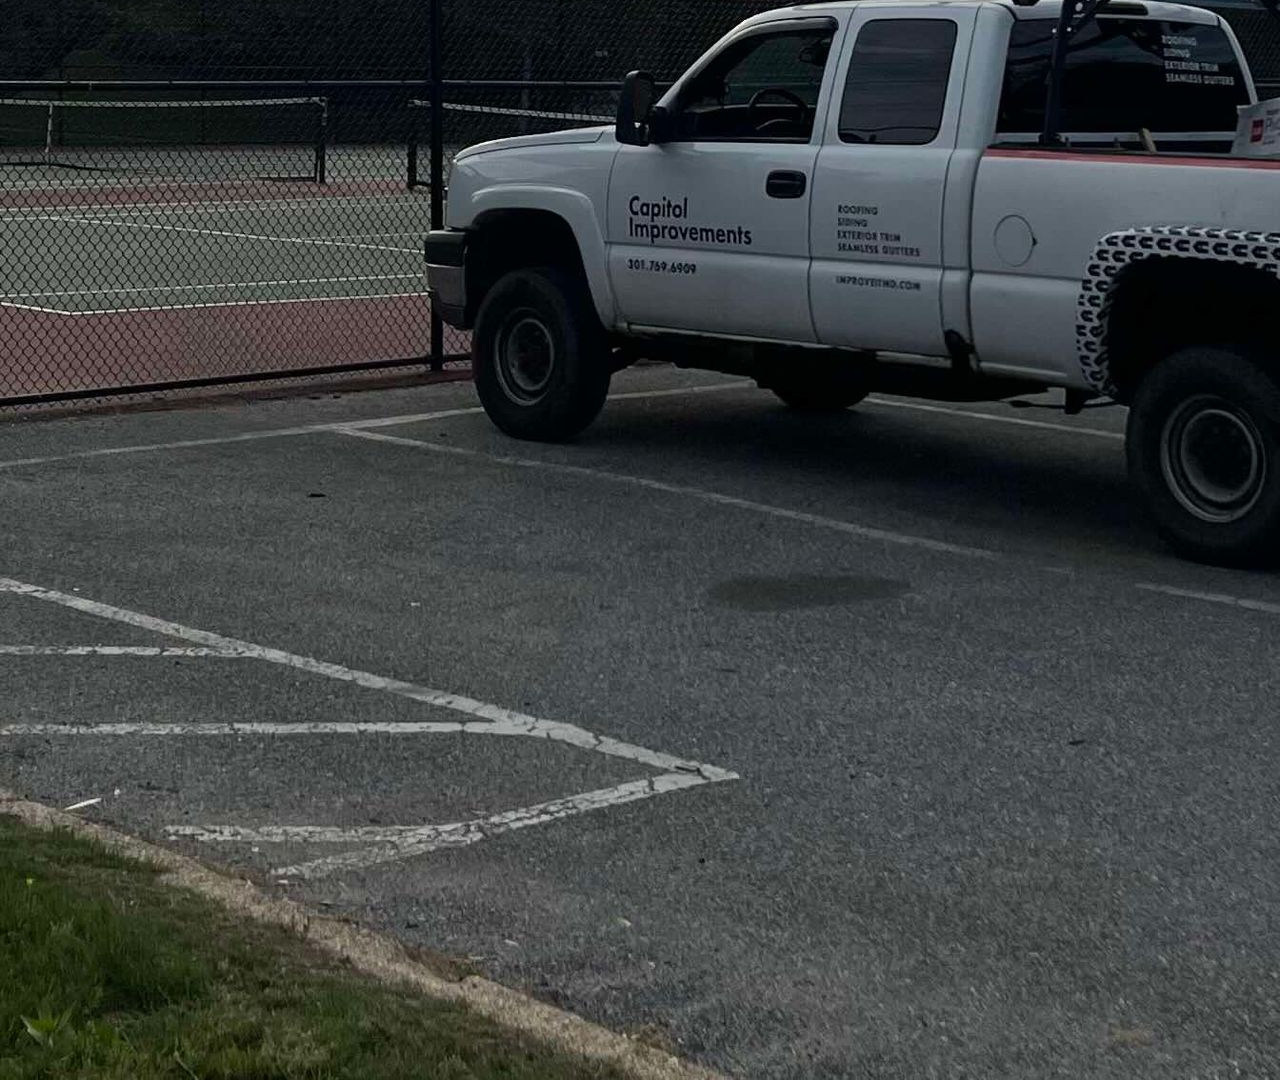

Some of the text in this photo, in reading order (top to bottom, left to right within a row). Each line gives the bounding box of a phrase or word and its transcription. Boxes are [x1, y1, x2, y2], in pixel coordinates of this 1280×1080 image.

[629, 195, 688, 222] Capitol
[629, 217, 752, 245] Improvements
[838, 230, 877, 241] EXTERIOR
[627, 259, 696, 274] 301.769.6909
